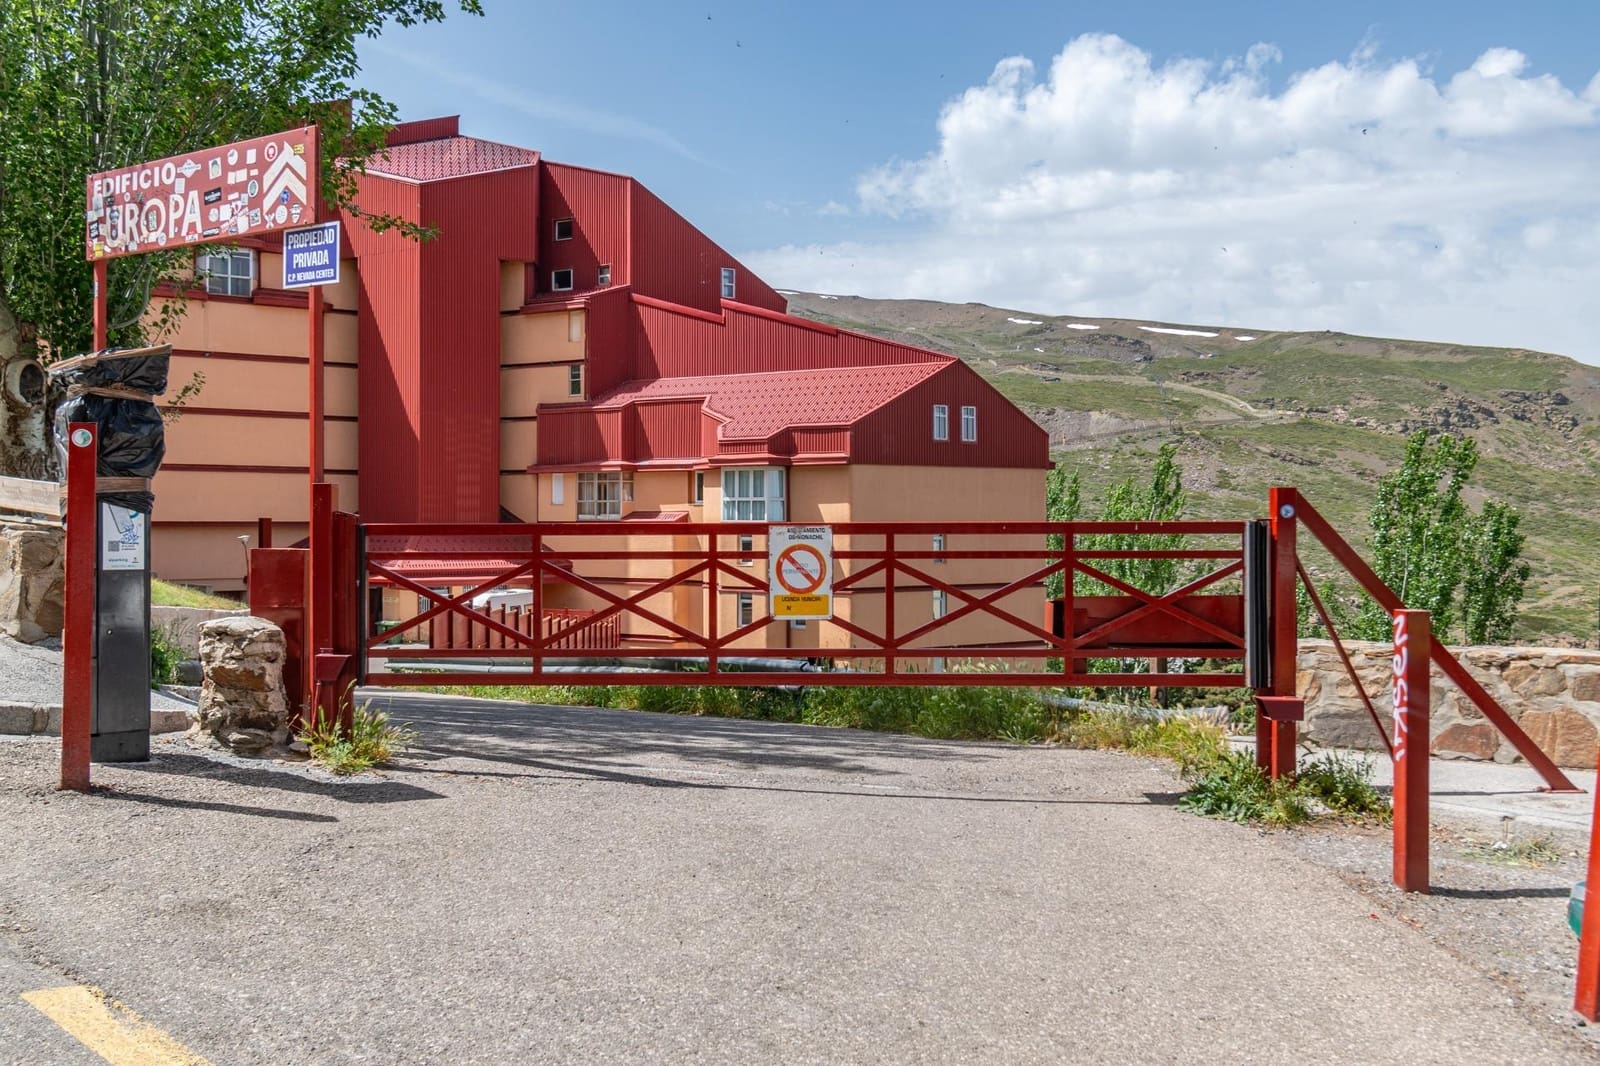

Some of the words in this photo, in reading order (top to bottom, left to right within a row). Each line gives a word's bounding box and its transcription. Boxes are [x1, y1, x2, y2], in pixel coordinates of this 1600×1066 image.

[93, 162, 176, 197] EDIFICIO
[93, 190, 202, 248] UROPA
[287, 228, 335, 250] PROPIEDAD
[293, 249, 329, 269] PRIVADA
[297, 270, 315, 281] NEVADA
[315, 268, 334, 279] CENTER
